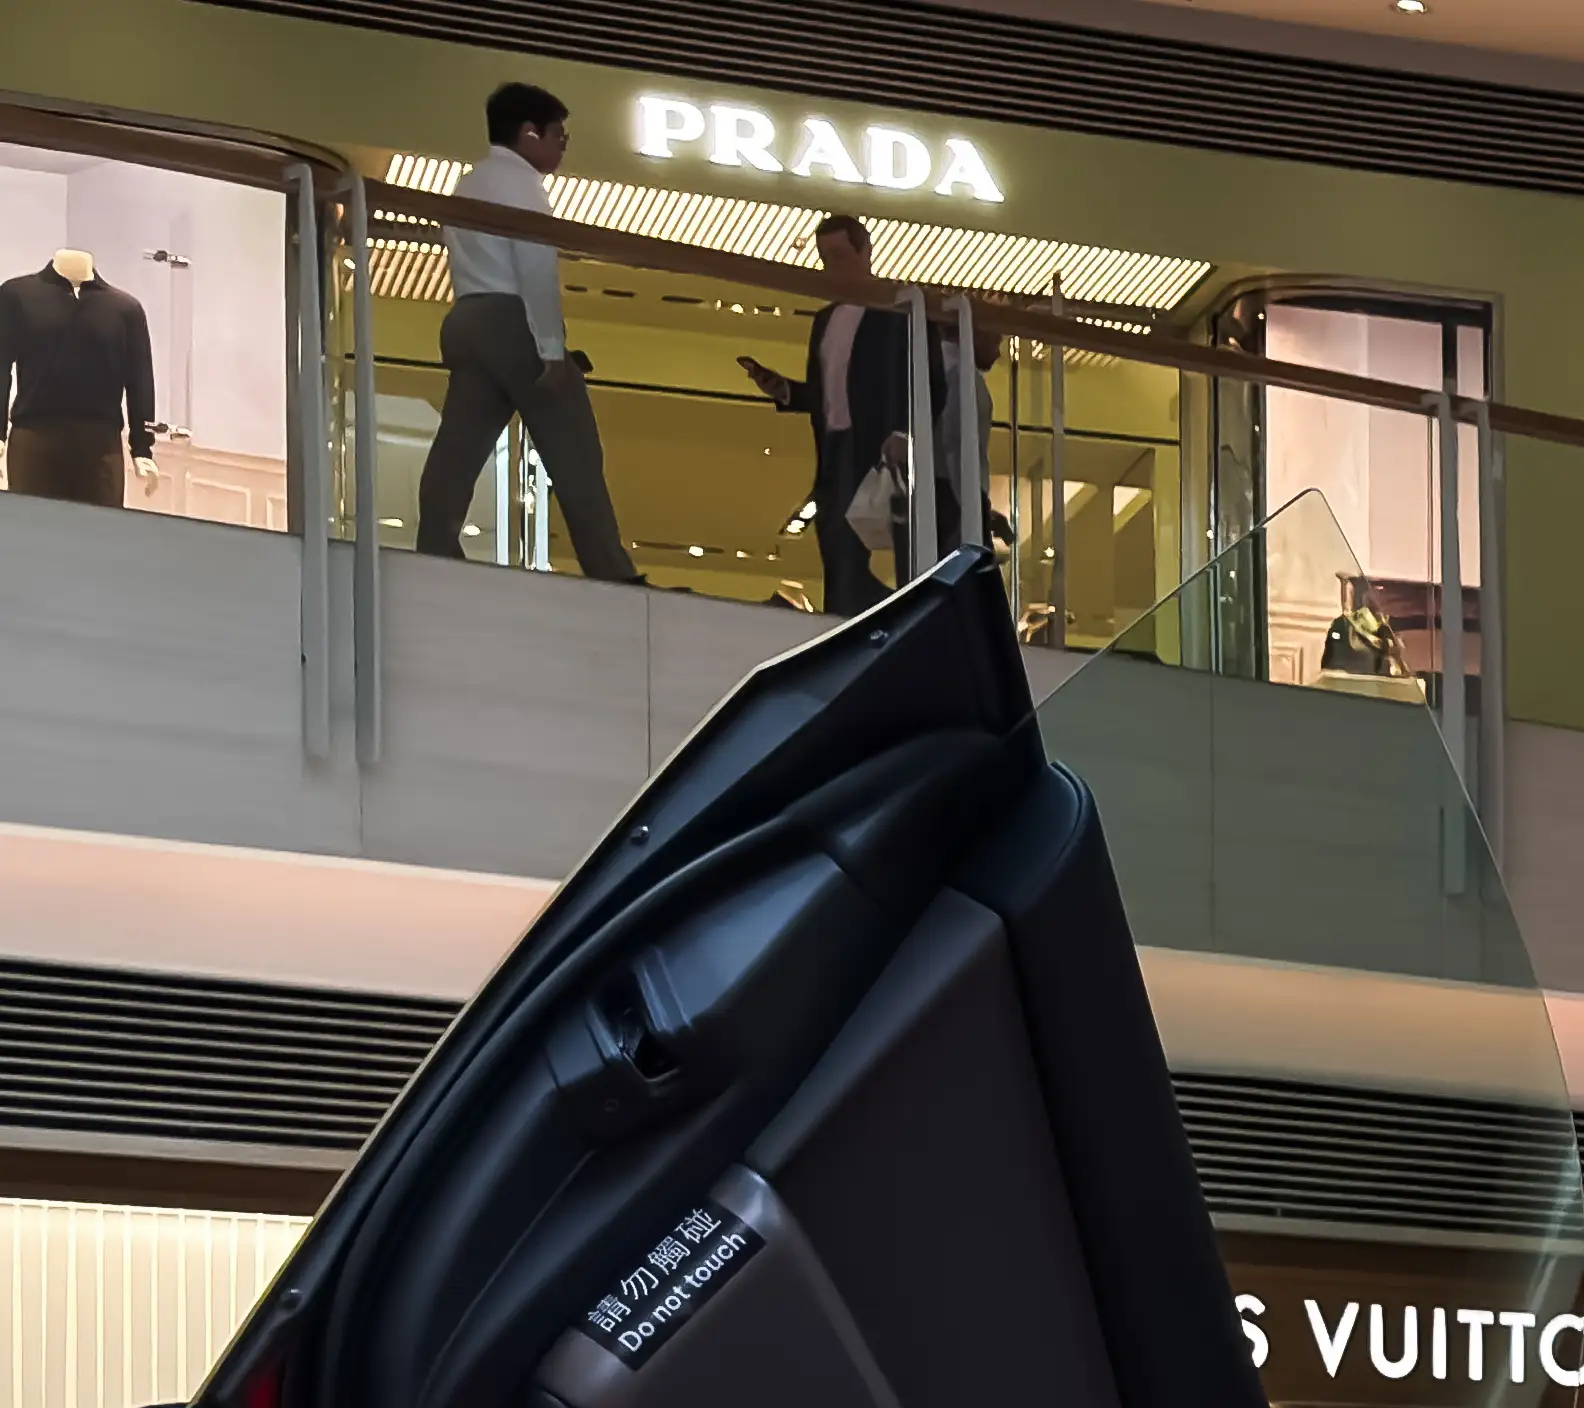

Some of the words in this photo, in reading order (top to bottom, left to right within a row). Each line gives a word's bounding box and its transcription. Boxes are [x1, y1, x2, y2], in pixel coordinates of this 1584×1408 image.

[635, 96, 1005, 204] PRADA
[588, 1208, 722, 1333] 請勿觸碰
[618, 1321, 655, 1352] Do
[652, 1285, 692, 1323] not
[683, 1232, 747, 1288] touch
